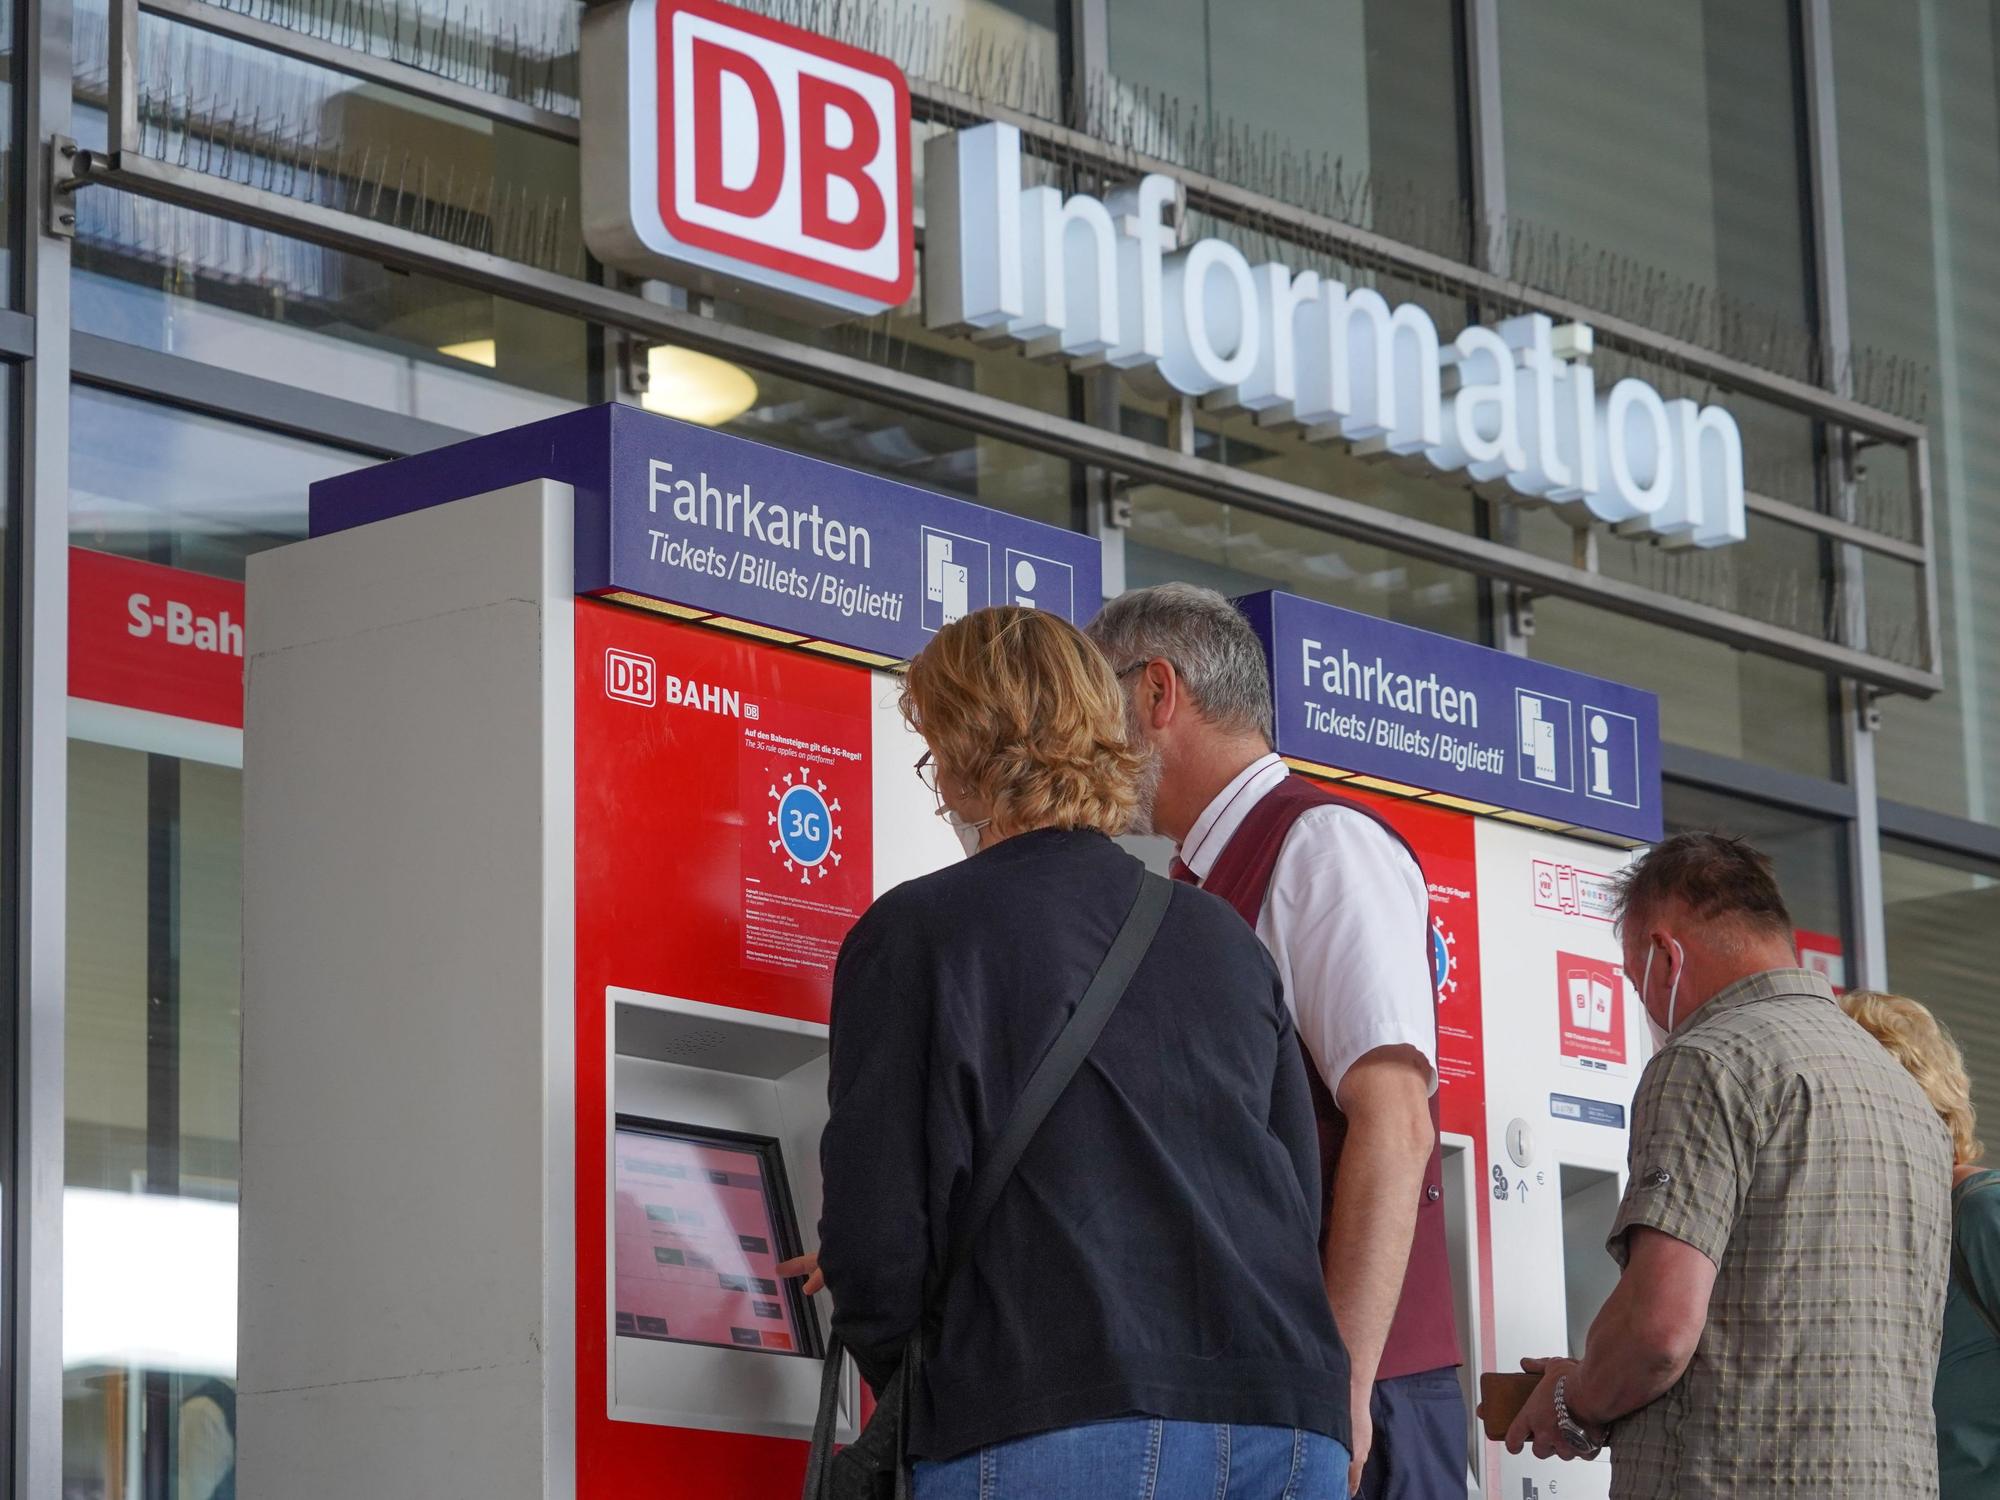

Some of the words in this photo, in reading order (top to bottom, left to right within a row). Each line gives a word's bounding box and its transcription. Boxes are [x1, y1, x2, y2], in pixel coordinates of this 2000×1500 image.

[689, 35, 888, 252] DB
[962, 120, 1747, 549] Information
[648, 457, 873, 570] Fahrkarten
[612, 657, 649, 697] DB
[665, 674, 740, 719] BAHN
[1301, 637, 1479, 728] Fahrkarten
[745, 704, 759, 719] DB
[745, 728, 757, 738] Auf
[757, 730, 770, 741] den
[770, 733, 809, 750] Bahnsteigen
[809, 742, 821, 752] gilt
[821, 744, 831, 754] die
[832, 747, 862, 761] 3G-Regel!
[745, 738, 756, 748] The
[756, 740, 765, 750] 3G
[765, 743, 777, 753] rule
[777, 746, 798, 758] applies
[798, 751, 806, 760] on
[788, 809, 821, 843] 3G
